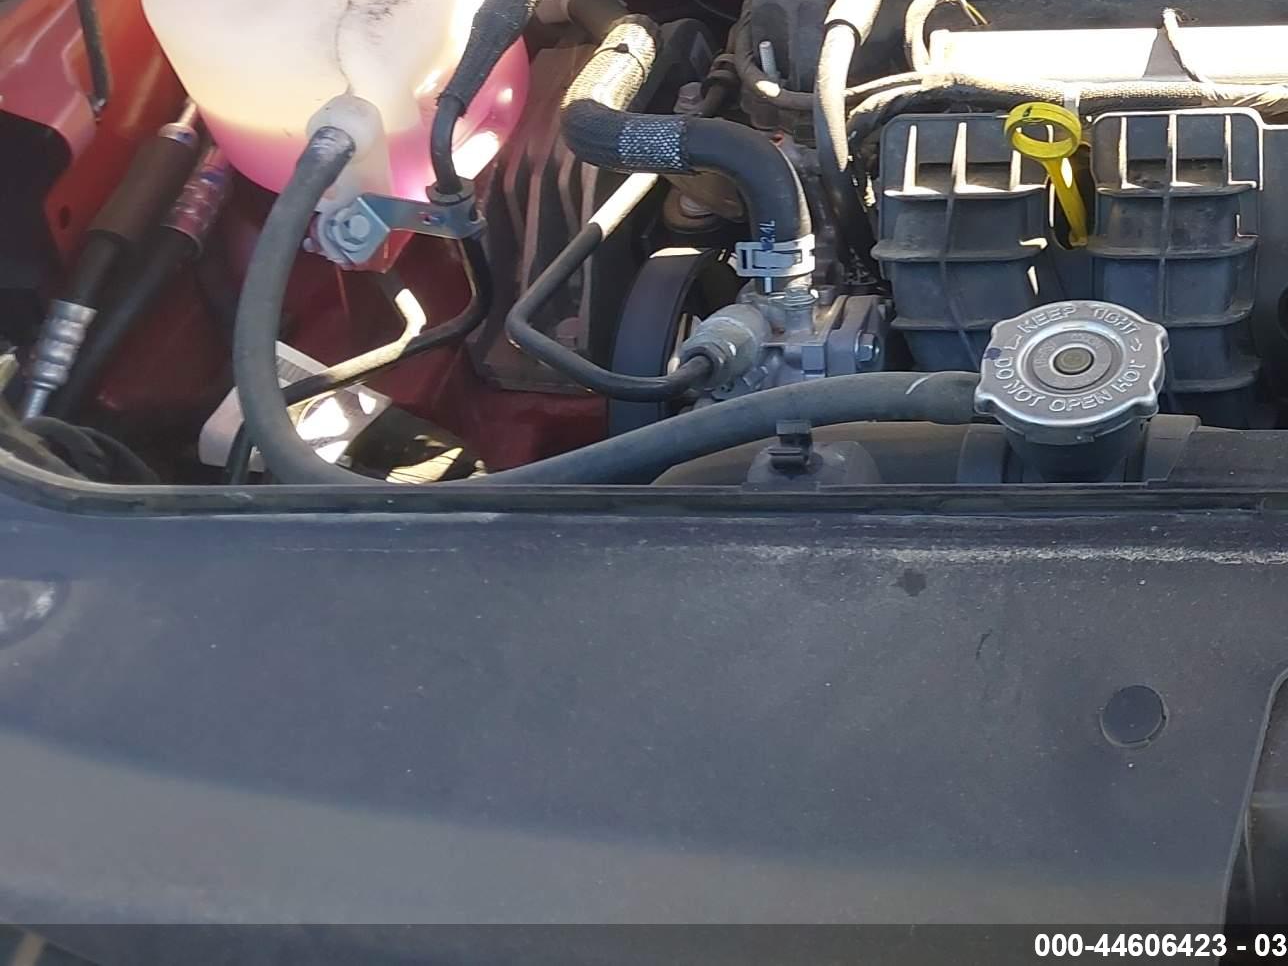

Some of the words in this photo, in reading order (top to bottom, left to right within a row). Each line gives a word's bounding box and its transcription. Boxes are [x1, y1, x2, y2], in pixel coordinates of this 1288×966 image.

[1016, 306, 1078, 334] KEEP
[1092, 306, 1142, 335] TIGHT
[994, 357, 1016, 380] DO
[1111, 359, 1147, 394] HOT
[1003, 379, 1046, 407] NOT
[1048, 389, 1114, 412] OPEN
